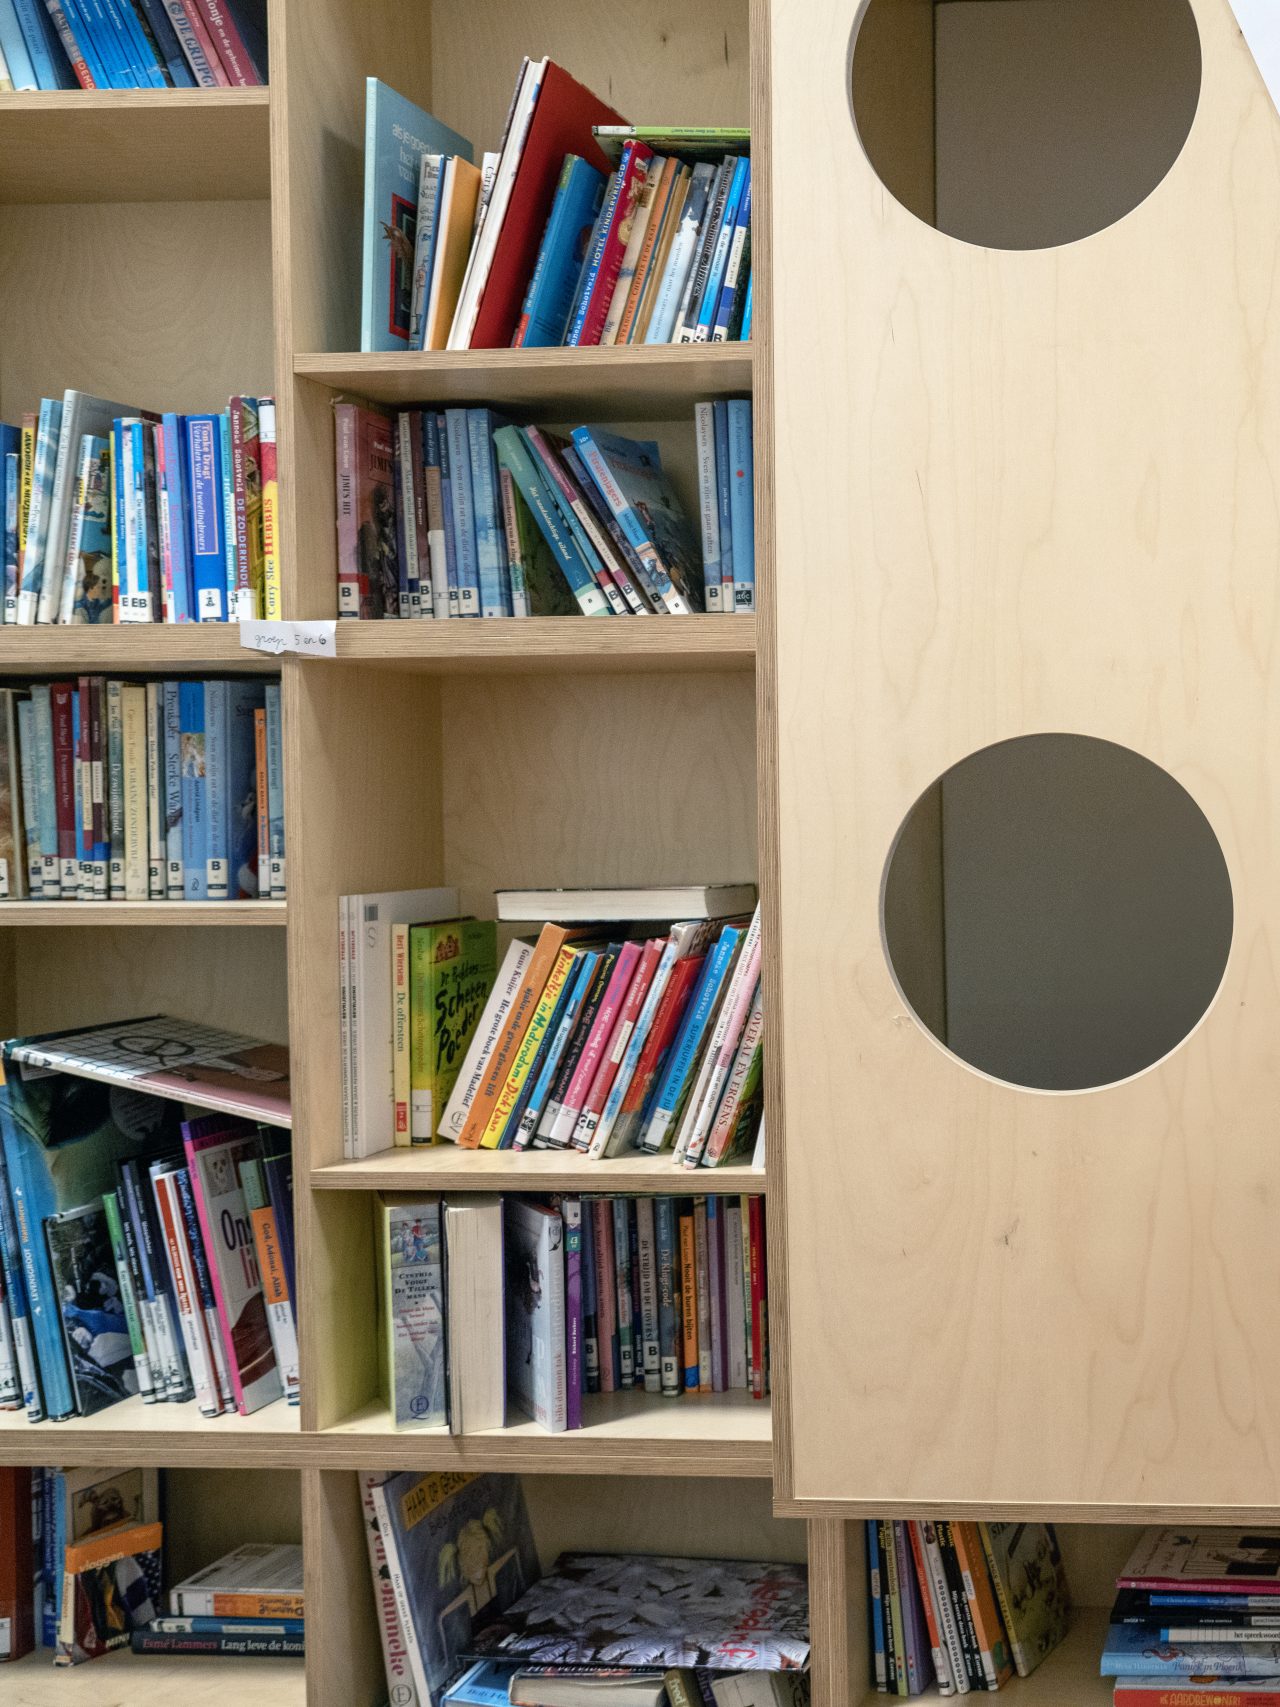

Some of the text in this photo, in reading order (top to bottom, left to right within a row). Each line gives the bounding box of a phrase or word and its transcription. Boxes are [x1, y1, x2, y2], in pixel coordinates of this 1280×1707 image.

[718, 163, 733, 193] Annie
[597, 162, 628, 235] KINDERVREUGD
[701, 216, 719, 255] Schmidt
[589, 234, 607, 267] HOTEL
[575, 270, 598, 316] Schotveld
[231, 409, 241, 444] Janneke
[342, 417, 350, 434] Paul
[451, 417, 463, 456] Nicolaysen
[200, 424, 211, 480] Tonke Dragt
[342, 449, 350, 469] Loon
[426, 446, 435, 464] Jonge
[232, 448, 245, 492] Schotveld
[455, 463, 464, 480] Sven
[585, 448, 624, 509] Piratenjagers
[698, 406, 715, 554] Nicolaysen Sven en zijn rat gaan raften
[192, 424, 206, 551] Verhalen van de tweelingbroers
[340, 473, 351, 499] JIMI'S
[456, 481, 464, 491] en
[235, 497, 245, 511] DE
[342, 500, 351, 517] HIT
[455, 491, 466, 506] zijn
[458, 506, 466, 516] rat
[460, 527, 468, 537] de
[263, 497, 278, 615] Carry Slee HEBBES
[341, 587, 351, 597] B
[412, 595, 420, 605] B
[421, 585, 429, 595] B
[709, 587, 718, 597] B
[294, 634, 300, 645] 5
[304, 637, 316, 645] en
[318, 633, 327, 645] 6
[193, 779, 201, 823] Astrid Lindgren
[211, 861, 221, 870] B
[710, 939, 731, 976] Janneke
[395, 934, 406, 1052] Bert Wiersema De offersteen
[694, 977, 716, 1021] Schotveld
[460, 947, 530, 1109] Guus Kuijer Het grote boek van Madelief
[487, 947, 575, 1135] Pinkeltje in Madurodam Dick Laan
[500, 1029, 516, 1053] grote
[548, 1024, 568, 1062] Brugpiepers
[674, 1022, 700, 1074] SUPERJUFFIE
[671, 1073, 681, 1084] IN
[711, 1009, 766, 1137] OVERAL EN ERGENS...
[483, 1080, 497, 1098] lift
[666, 1084, 677, 1098] DE
[15, 1198, 39, 1302] LEVENSGROOT Waterdieren
[640, 1239, 649, 1251] DE
[260, 1221, 274, 1243] God,
[269, 1274, 283, 1298] Allah
[641, 1251, 650, 1279] STRIJD
[398, 1271, 433, 1280] CYNTHIA
[682, 1262, 692, 1284] Nooit
[643, 1280, 650, 1293] OM
[684, 1284, 693, 1295] de
[643, 1294, 651, 1306] DE
[684, 1295, 693, 1317] buren
[684, 1318, 694, 1340] bijten
[648, 1345, 657, 1356] B
[664, 1362, 673, 1372] B
[877, 1525, 887, 1549] Papier
[935, 1523, 946, 1547] Plastic
[950, 1589, 959, 1604] Mijn
[986, 1552, 1013, 1632] LANGS HET STRAND
[954, 1602, 962, 1621] eerste
[381, 1583, 408, 1677] Janneke
[960, 1633, 969, 1648] boek
[1234, 1630, 1243, 1640] het
[142, 1637, 304, 1652] Esmé Lammers Lang leve de koni
